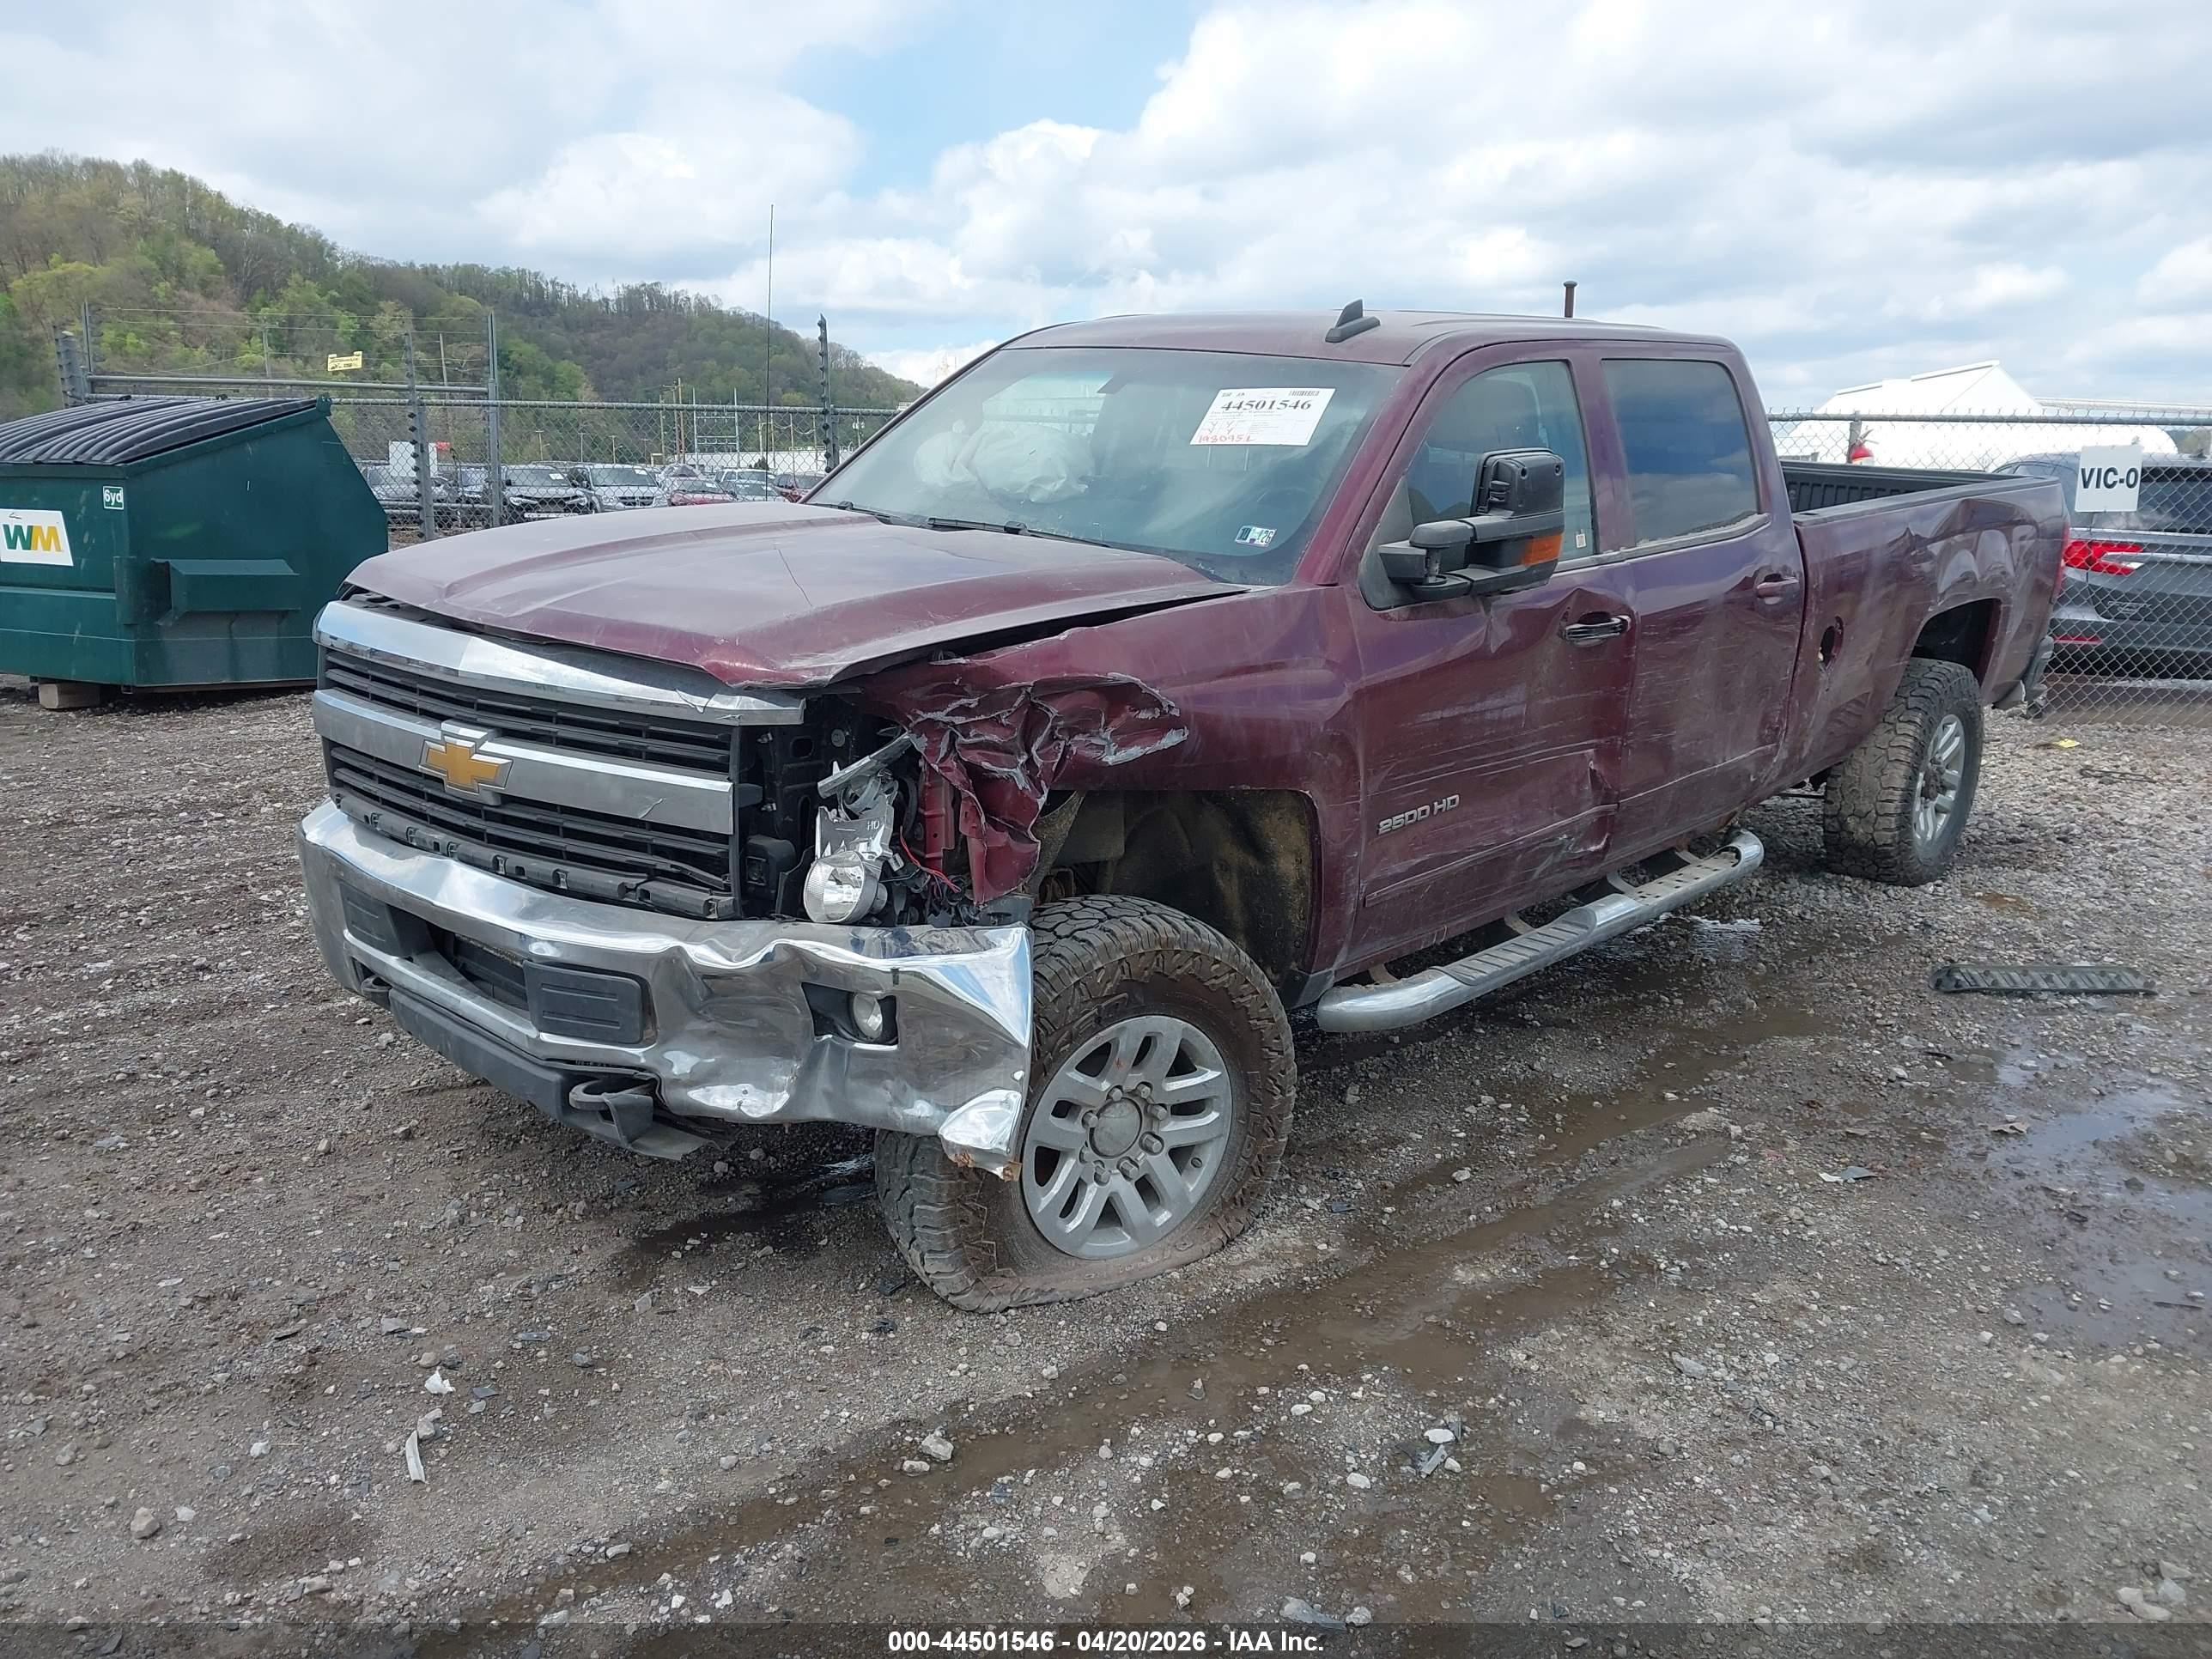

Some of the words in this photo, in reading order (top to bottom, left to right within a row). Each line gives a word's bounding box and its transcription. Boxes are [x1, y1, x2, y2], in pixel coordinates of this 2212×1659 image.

[1221, 400, 1312, 411] 44501546
[104, 489, 123, 506] 6yd
[3, 524, 63, 552] WM
[1377, 805, 1431, 835] 2500
[1432, 794, 1460, 816] HD
[866, 820, 880, 830] HD
